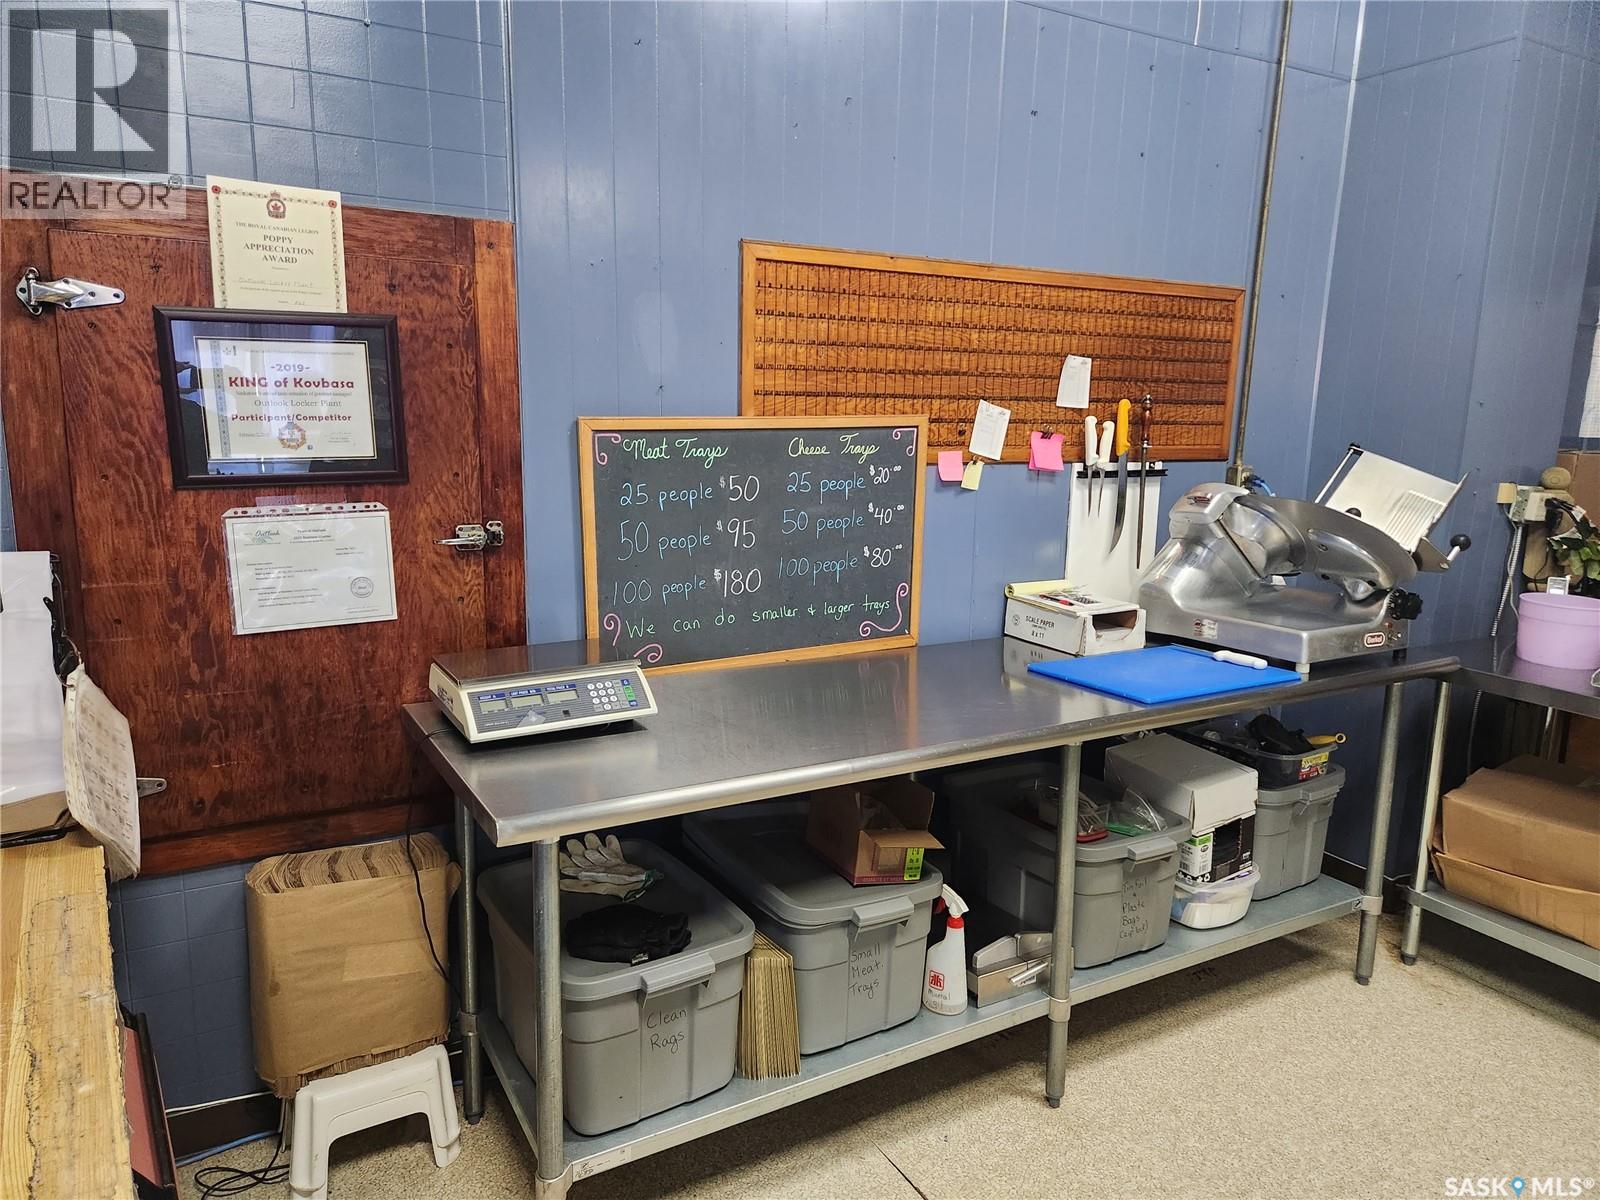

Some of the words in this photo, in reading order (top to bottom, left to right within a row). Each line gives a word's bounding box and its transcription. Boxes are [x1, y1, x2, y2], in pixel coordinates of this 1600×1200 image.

[243, 243, 314, 256] APPRECIATION
[263, 234, 293, 244] POPPY
[262, 254, 298, 264] AWARD
[228, 376, 268, 389] KING
[274, 377, 289, 389] of
[293, 377, 355, 389] Kovbasa
[254, 399, 289, 407] Outlook
[231, 413, 352, 423] Participant/Competitor
[623, 437, 670, 460] Meat
[675, 437, 729, 468] Trays
[788, 437, 831, 457] Cheese
[840, 433, 880, 464] Trays
[620, 482, 649, 506] 25
[658, 482, 713, 511] people
[719, 475, 760, 501] $50
[786, 471, 812, 493] 25
[820, 471, 866, 504] people
[782, 509, 809, 535] 50
[816, 509, 865, 539] people
[617, 519, 649, 561] 50
[658, 525, 712, 560] people
[716, 518, 756, 549] $95
[778, 556, 809, 579] 100
[813, 550, 858, 586] people
[613, 579, 652, 606] 100
[662, 574, 707, 605] people
[713, 568, 762, 598] $180
[626, 617, 656, 639] We
[673, 619, 701, 633] can
[714, 608, 736, 626] do
[752, 606, 798, 622] smaller
[824, 602, 855, 621] larger
[863, 594, 890, 616] trays
[1026, 616, 1040, 625] SCALE
[1040, 619, 1054, 628] PAPER
[850, 943, 881, 963] Small
[848, 978, 880, 999] Trays
[646, 1009, 687, 1029] Clean
[650, 1031, 685, 1054] Rags
